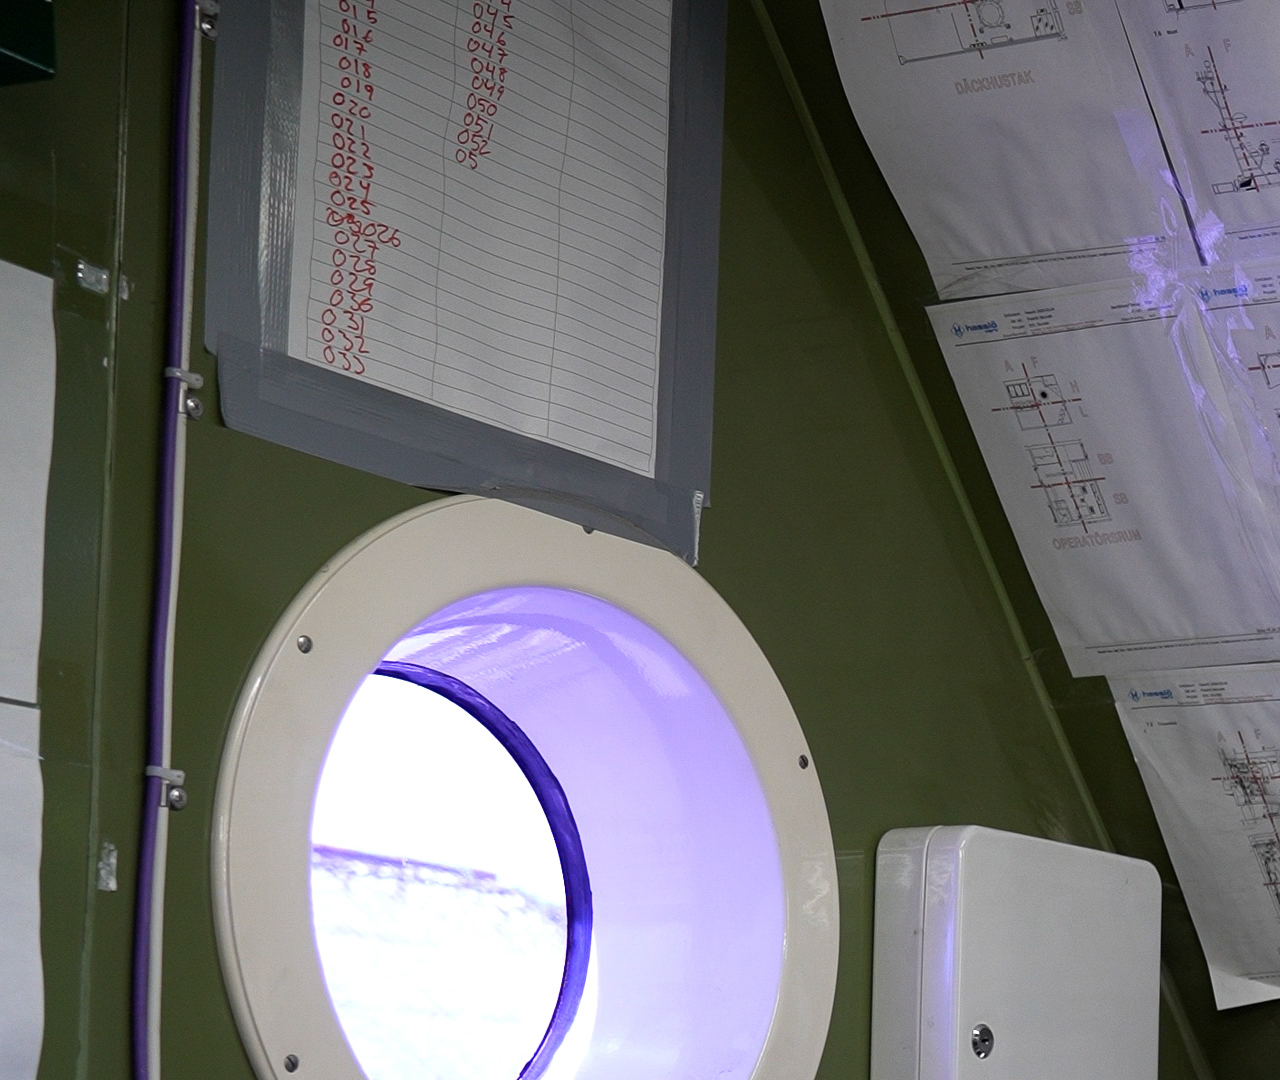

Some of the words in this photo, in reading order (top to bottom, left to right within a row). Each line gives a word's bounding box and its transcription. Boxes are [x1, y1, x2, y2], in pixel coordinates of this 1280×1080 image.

[339, 0, 377, 24] 015
[473, 2, 515, 30] 045
[341, 18, 373, 43] 016
[472, 21, 507, 46] 046
[333, 34, 367, 56] 017
[467, 38, 508, 64] 047
[1184, 43, 1195, 58] A
[1222, 38, 1232, 53] F
[338, 56, 371, 79] 018
[470, 57, 508, 83] 048
[341, 76, 374, 100] 019
[471, 76, 504, 101] 049
[954, 70, 1035, 96] DÄCKHUSTAK
[332, 92, 372, 119] 020
[466, 93, 498, 117] 050
[331, 113, 365, 141] 021
[463, 112, 494, 141] 051
[332, 132, 371, 160] 022
[457, 129, 491, 156] 052
[331, 153, 374, 180] 023
[455, 149, 478, 170] 05
[329, 171, 371, 201] 024
[330, 190, 377, 215] 025
[335, 230, 379, 260] 027
[333, 249, 377, 275] 028
[331, 269, 376, 297] 029
[321, 309, 365, 336] 031
[964, 320, 998, 333] hasslö
[1265, 325, 1276, 340] A
[321, 328, 370, 354] 032
[323, 346, 366, 375] 033
[1004, 360, 1014, 373] A
[1030, 356, 1039, 369] F
[1069, 381, 1080, 393] H
[1079, 406, 1088, 418] L
[1097, 453, 1115, 465] BB
[1112, 493, 1129, 505] SB
[1052, 529, 1142, 551] OPERATÖRSRUM
